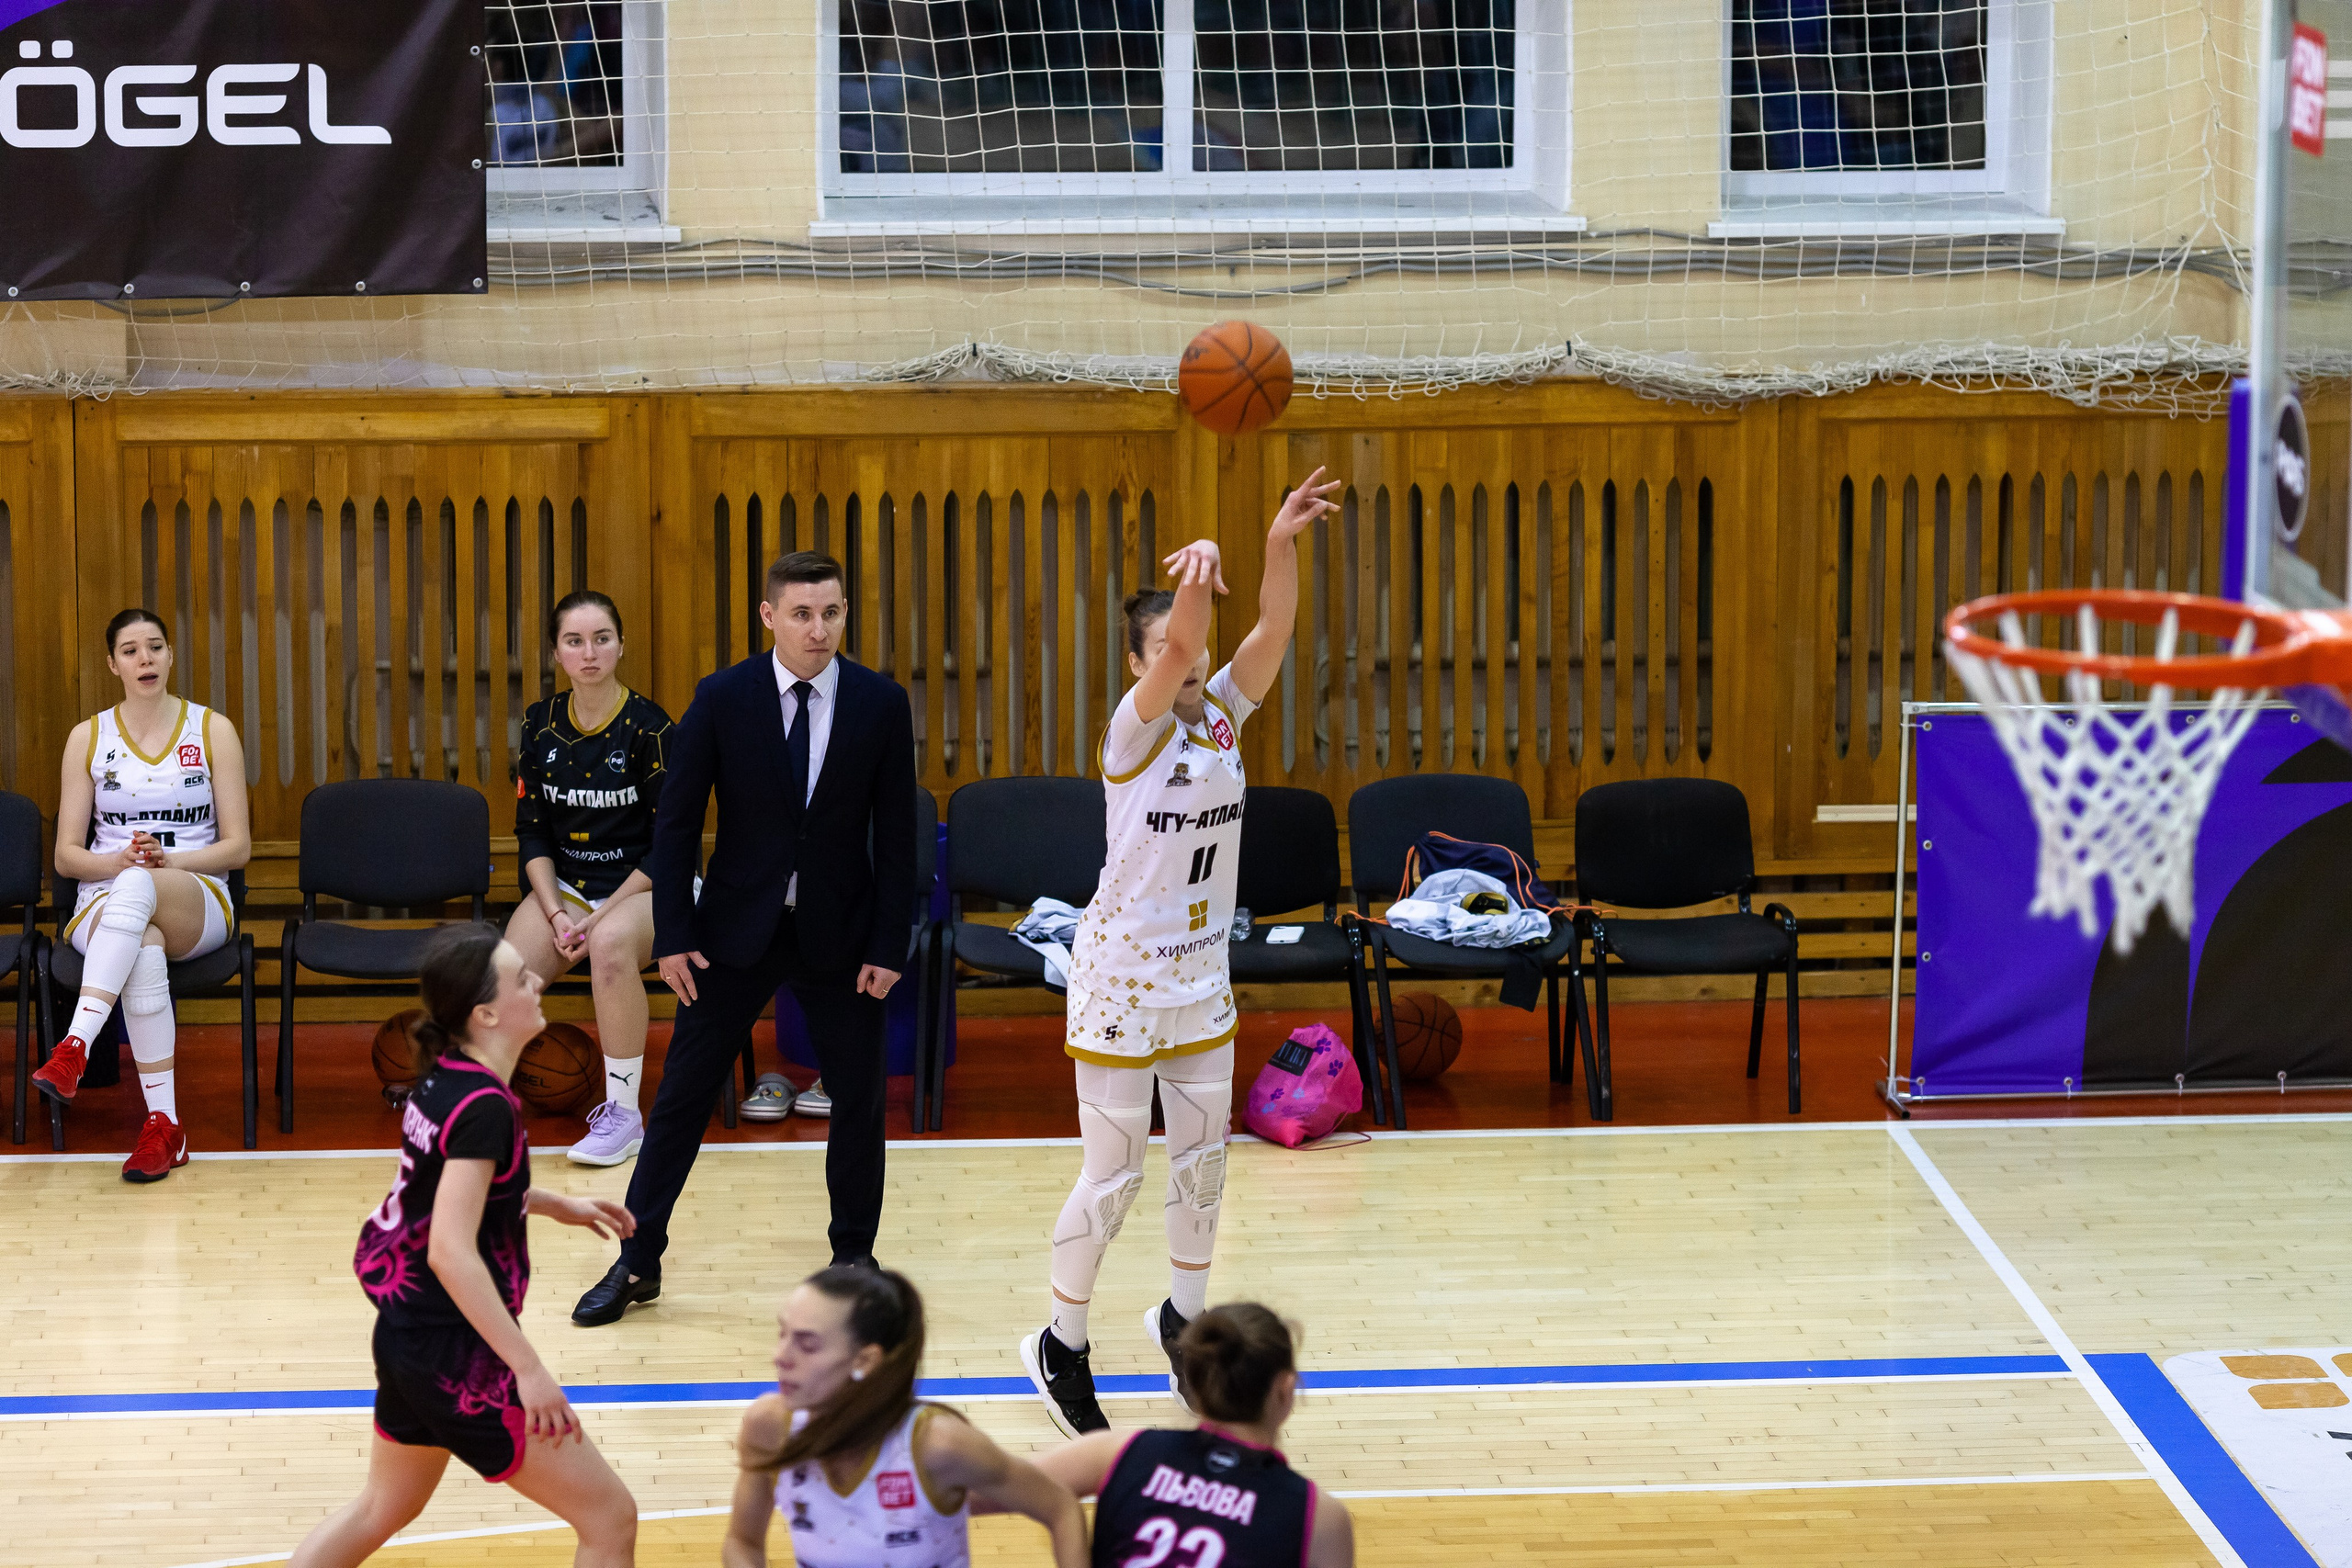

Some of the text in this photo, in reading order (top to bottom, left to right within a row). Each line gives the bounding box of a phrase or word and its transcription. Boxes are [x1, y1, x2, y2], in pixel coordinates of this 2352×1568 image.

[0, 39, 392, 148] ÖGEL
[1146, 788, 1246, 833] ЧГУ-АТЛА
[1187, 842, 1218, 885] 11
[1156, 928, 1225, 958] ХИМПРОМ
